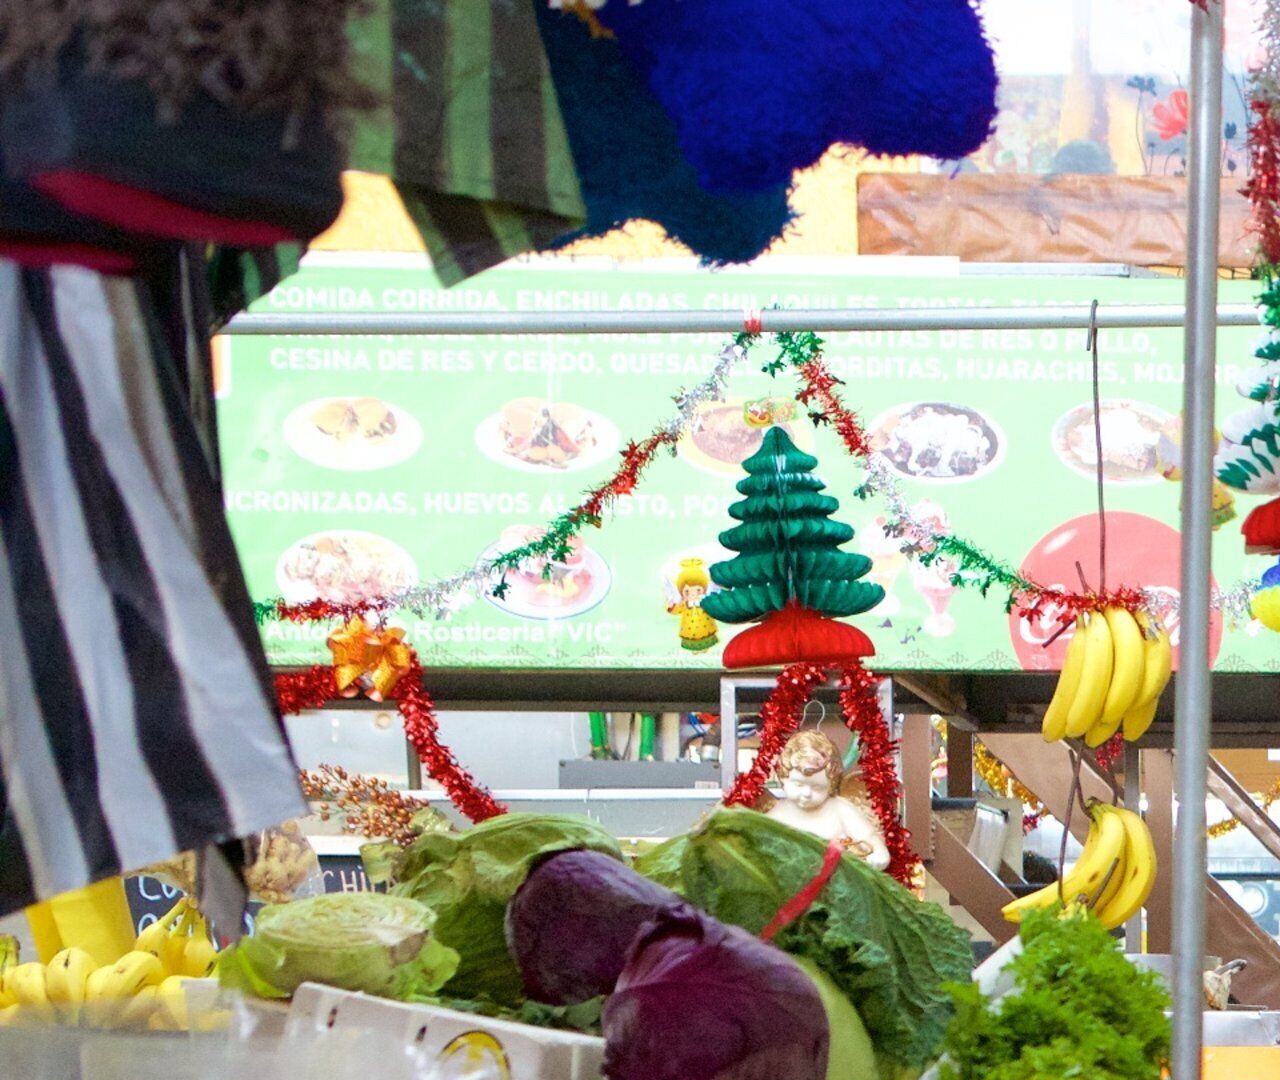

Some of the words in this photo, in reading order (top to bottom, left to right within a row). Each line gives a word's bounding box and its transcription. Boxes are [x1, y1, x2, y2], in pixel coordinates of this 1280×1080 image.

[270, 287, 372, 309] COMIDA
[269, 349, 371, 370] CESINA
[378, 350, 414, 370] DE
[421, 351, 474, 371] RES
[479, 351, 499, 371] Y
[424, 491, 531, 514] HUEVOS
